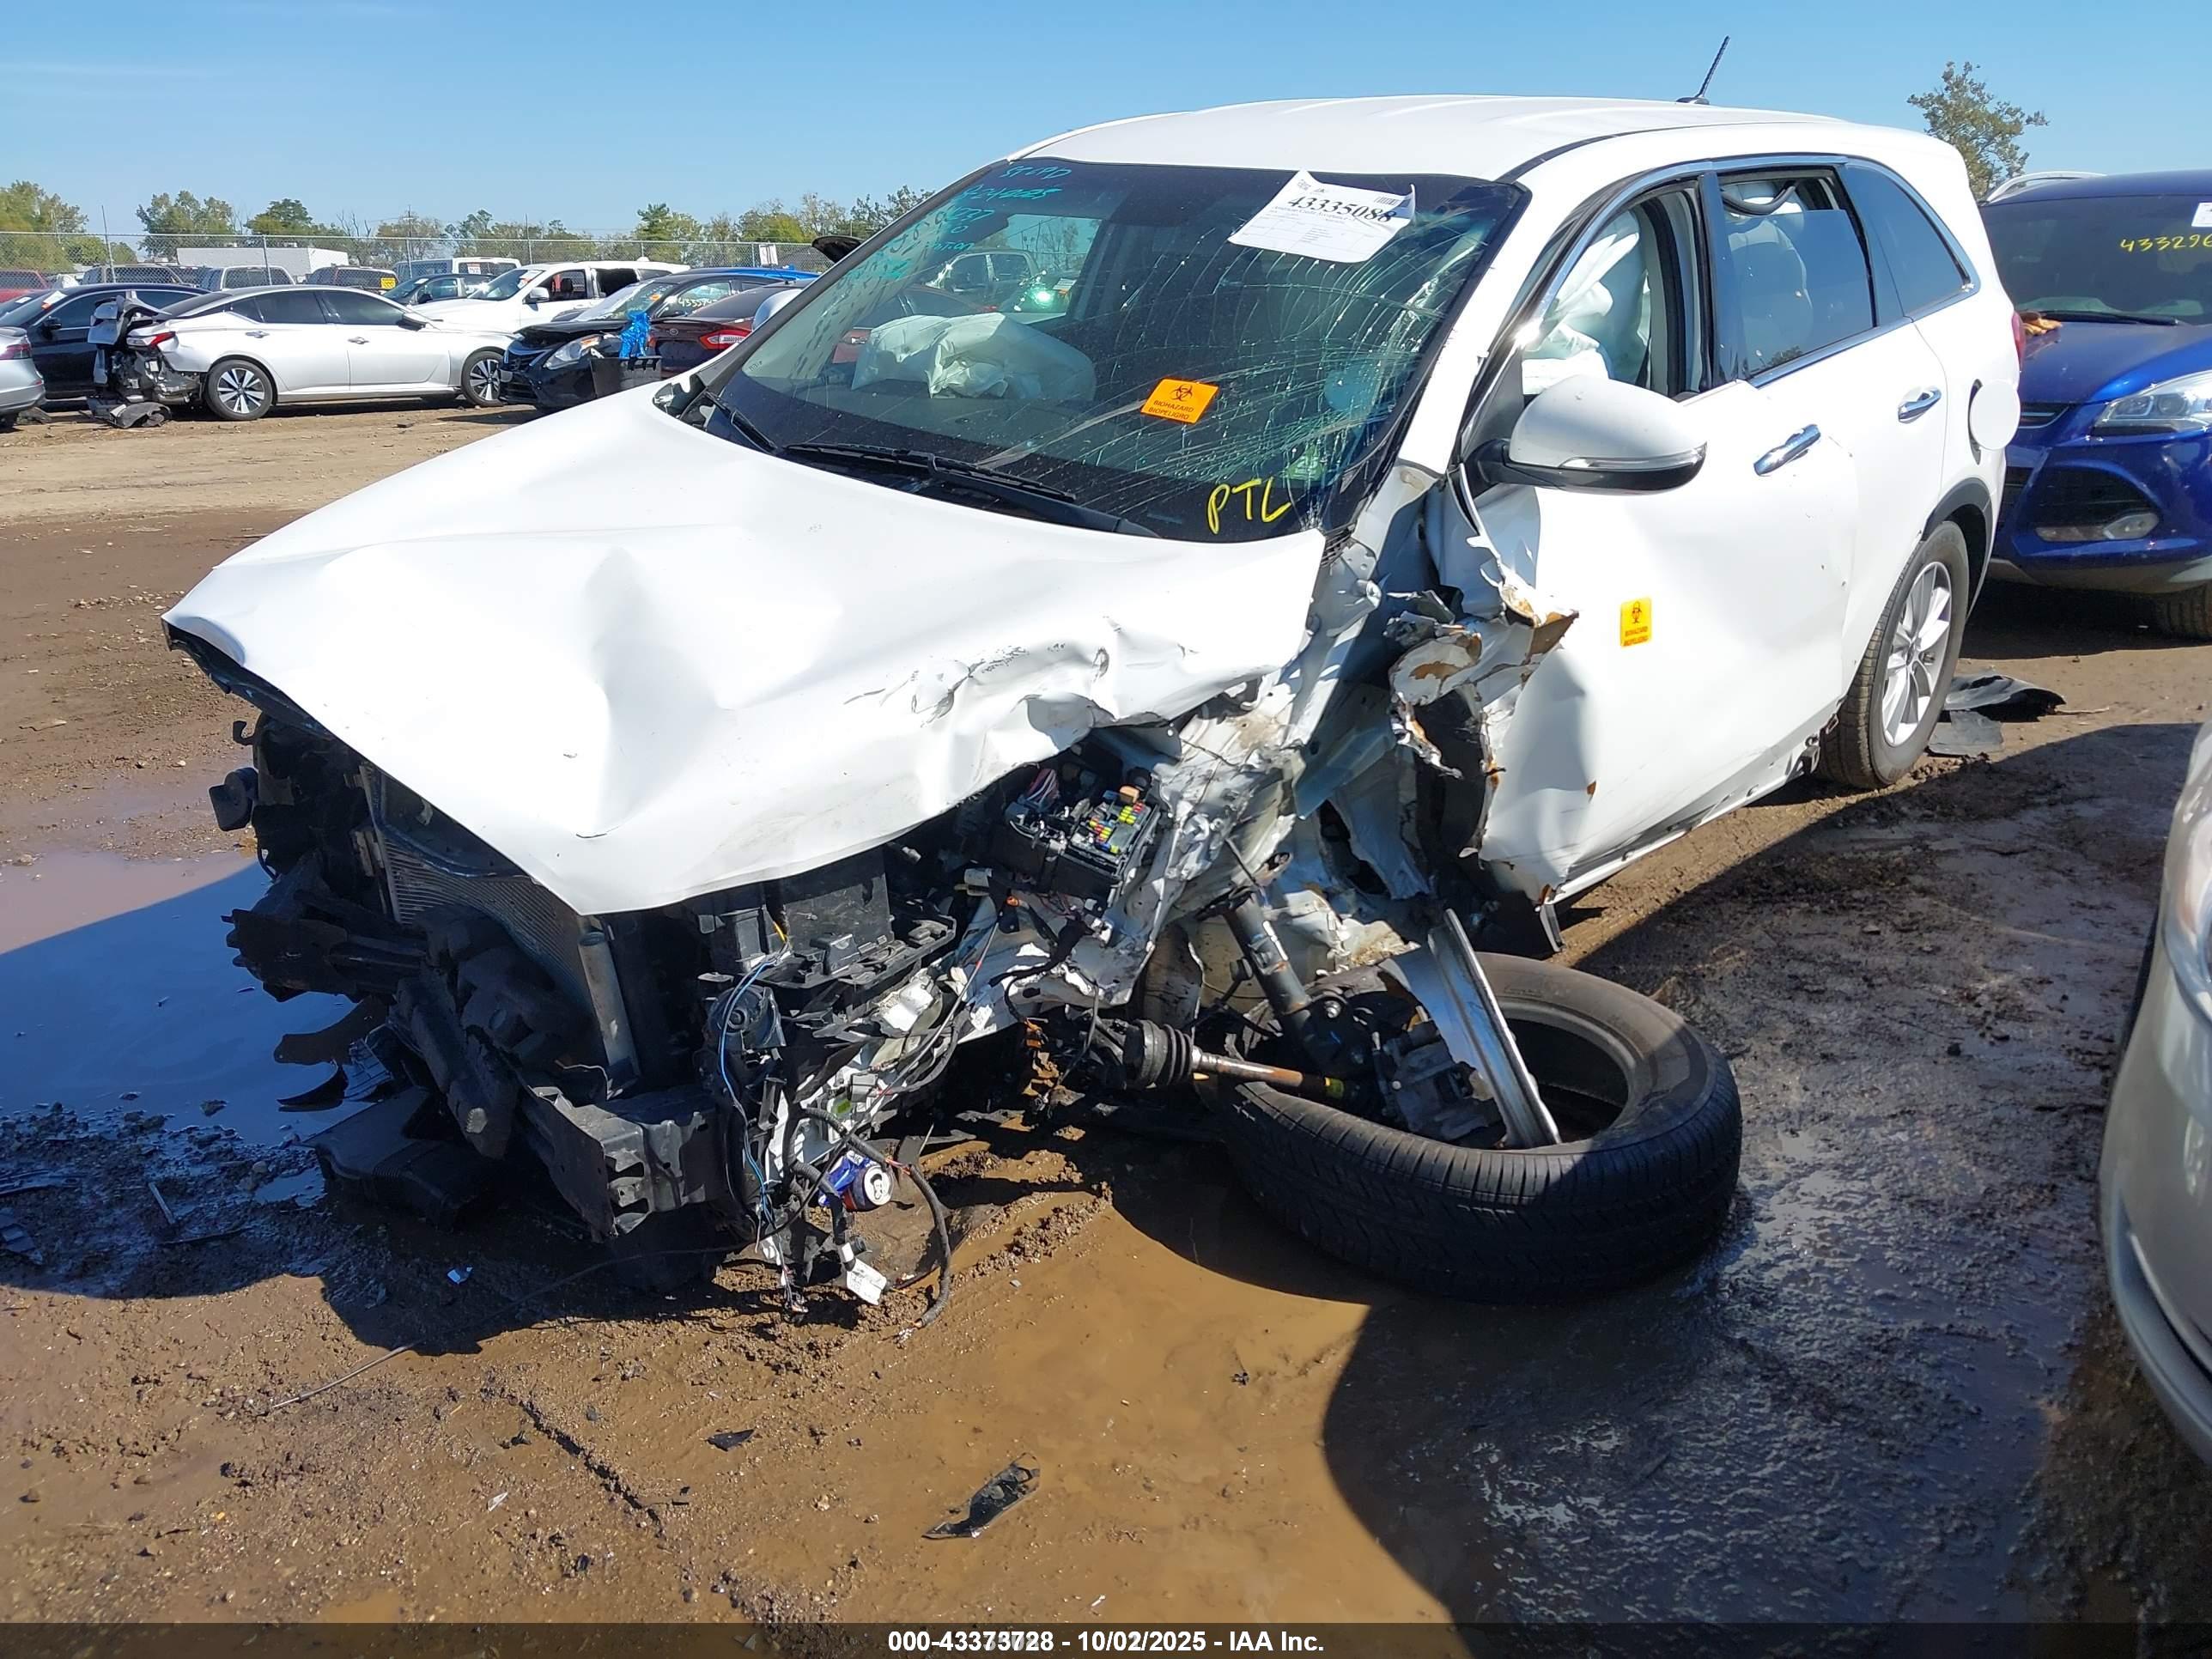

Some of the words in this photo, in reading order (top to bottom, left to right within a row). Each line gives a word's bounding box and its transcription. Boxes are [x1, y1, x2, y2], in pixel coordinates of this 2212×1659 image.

[1288, 196, 1397, 222] 43335088
[1148, 407, 1189, 420] BIOPELIGRO
[1153, 400, 1194, 412] BIOHAZARD
[1206, 476, 1291, 535] PTL
